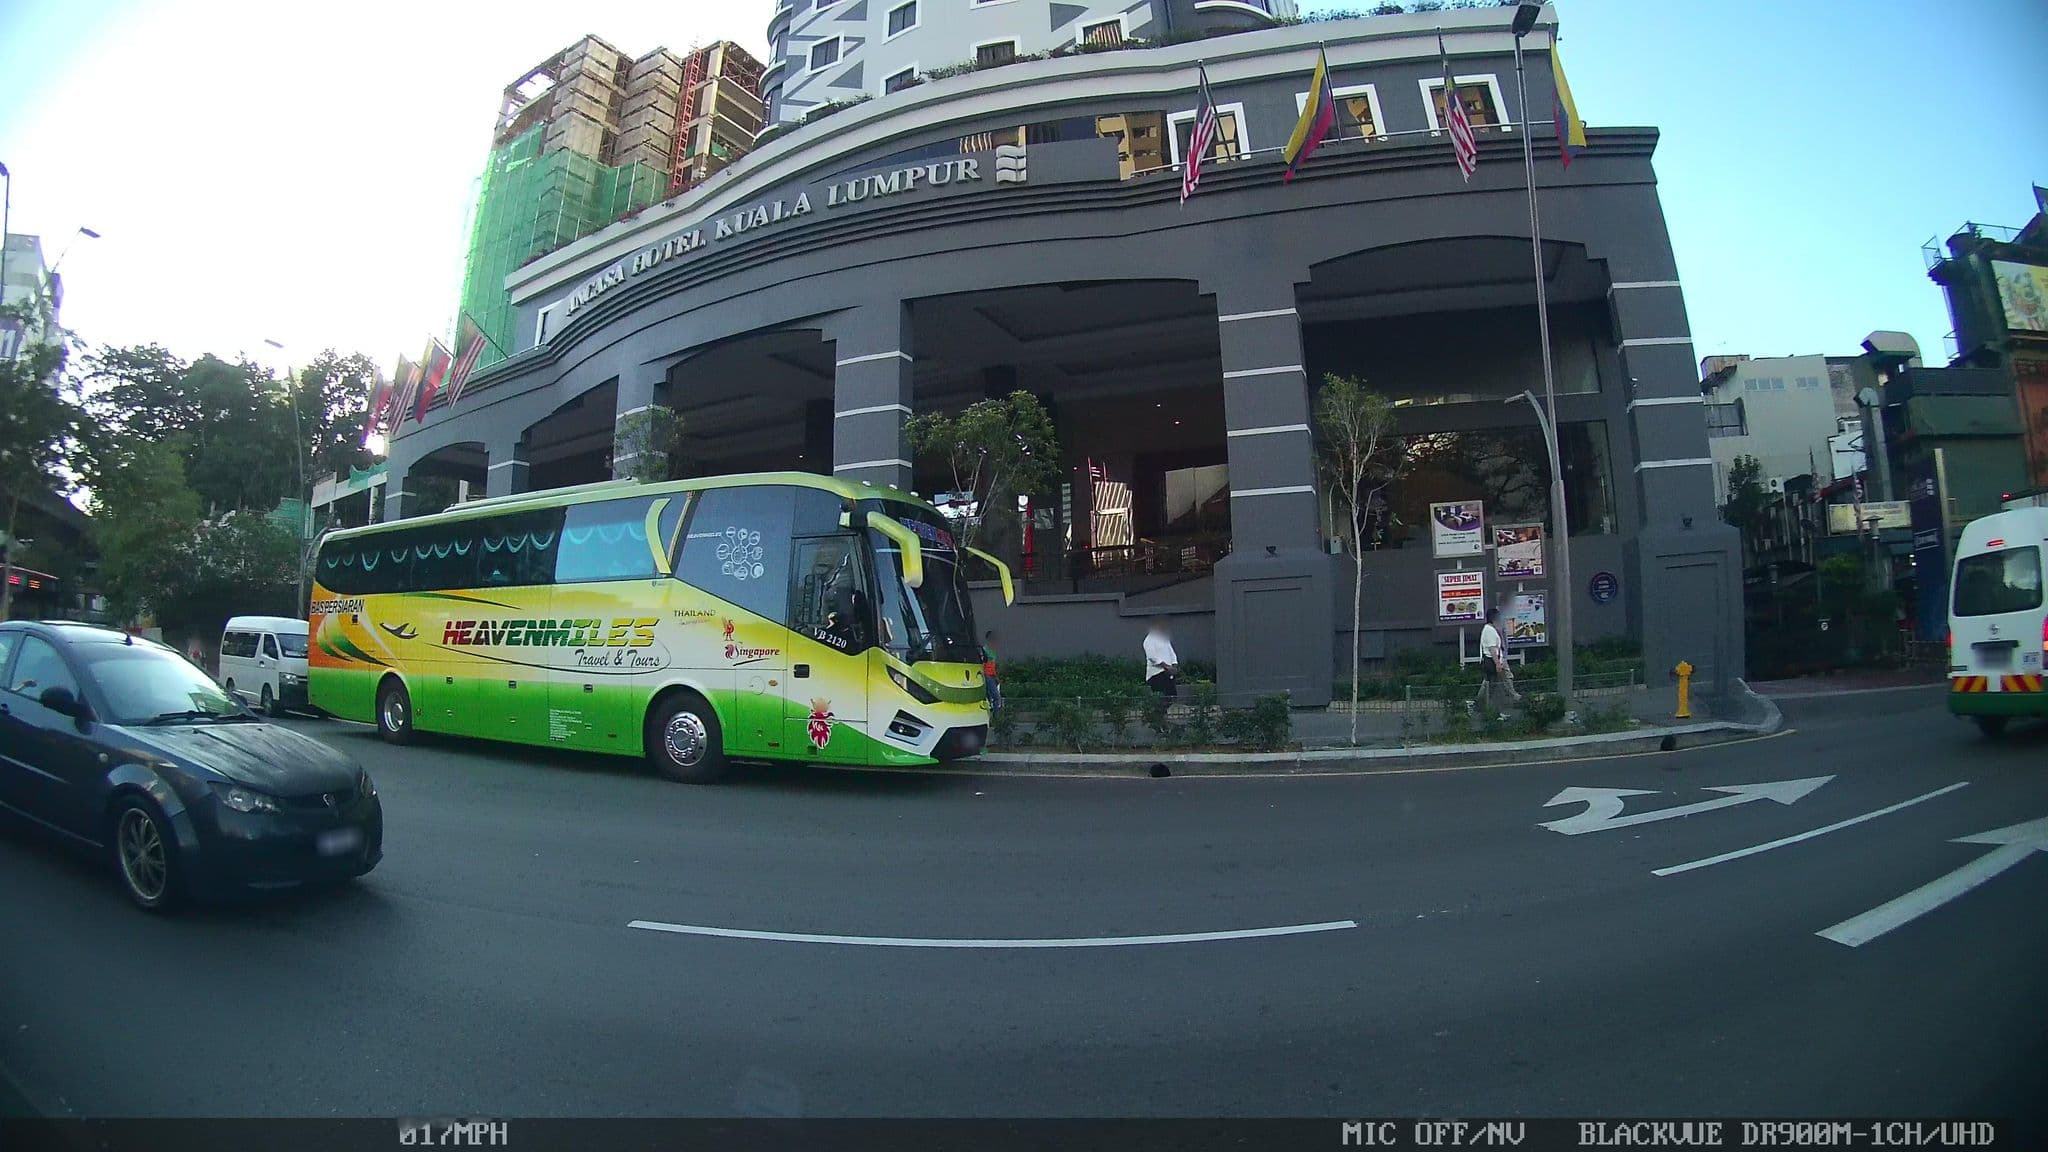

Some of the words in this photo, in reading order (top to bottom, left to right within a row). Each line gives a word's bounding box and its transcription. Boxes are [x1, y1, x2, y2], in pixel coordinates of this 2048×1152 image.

[566, 265, 626, 317] ANCASA
[632, 228, 707, 276] HOTEL
[714, 192, 812, 241] KUALA
[827, 158, 979, 206] LUMPUR
[310, 600, 325, 614] BAS
[324, 599, 365, 613] PERSIARAN
[674, 609, 716, 617] THAILAND
[442, 618, 660, 647] HEAVENMILES
[826, 634, 847, 649] 2120
[575, 648, 610, 667] Travel
[613, 649, 623, 666] &
[626, 649, 660, 667] Tours
[725, 641, 780, 659] Singapore
